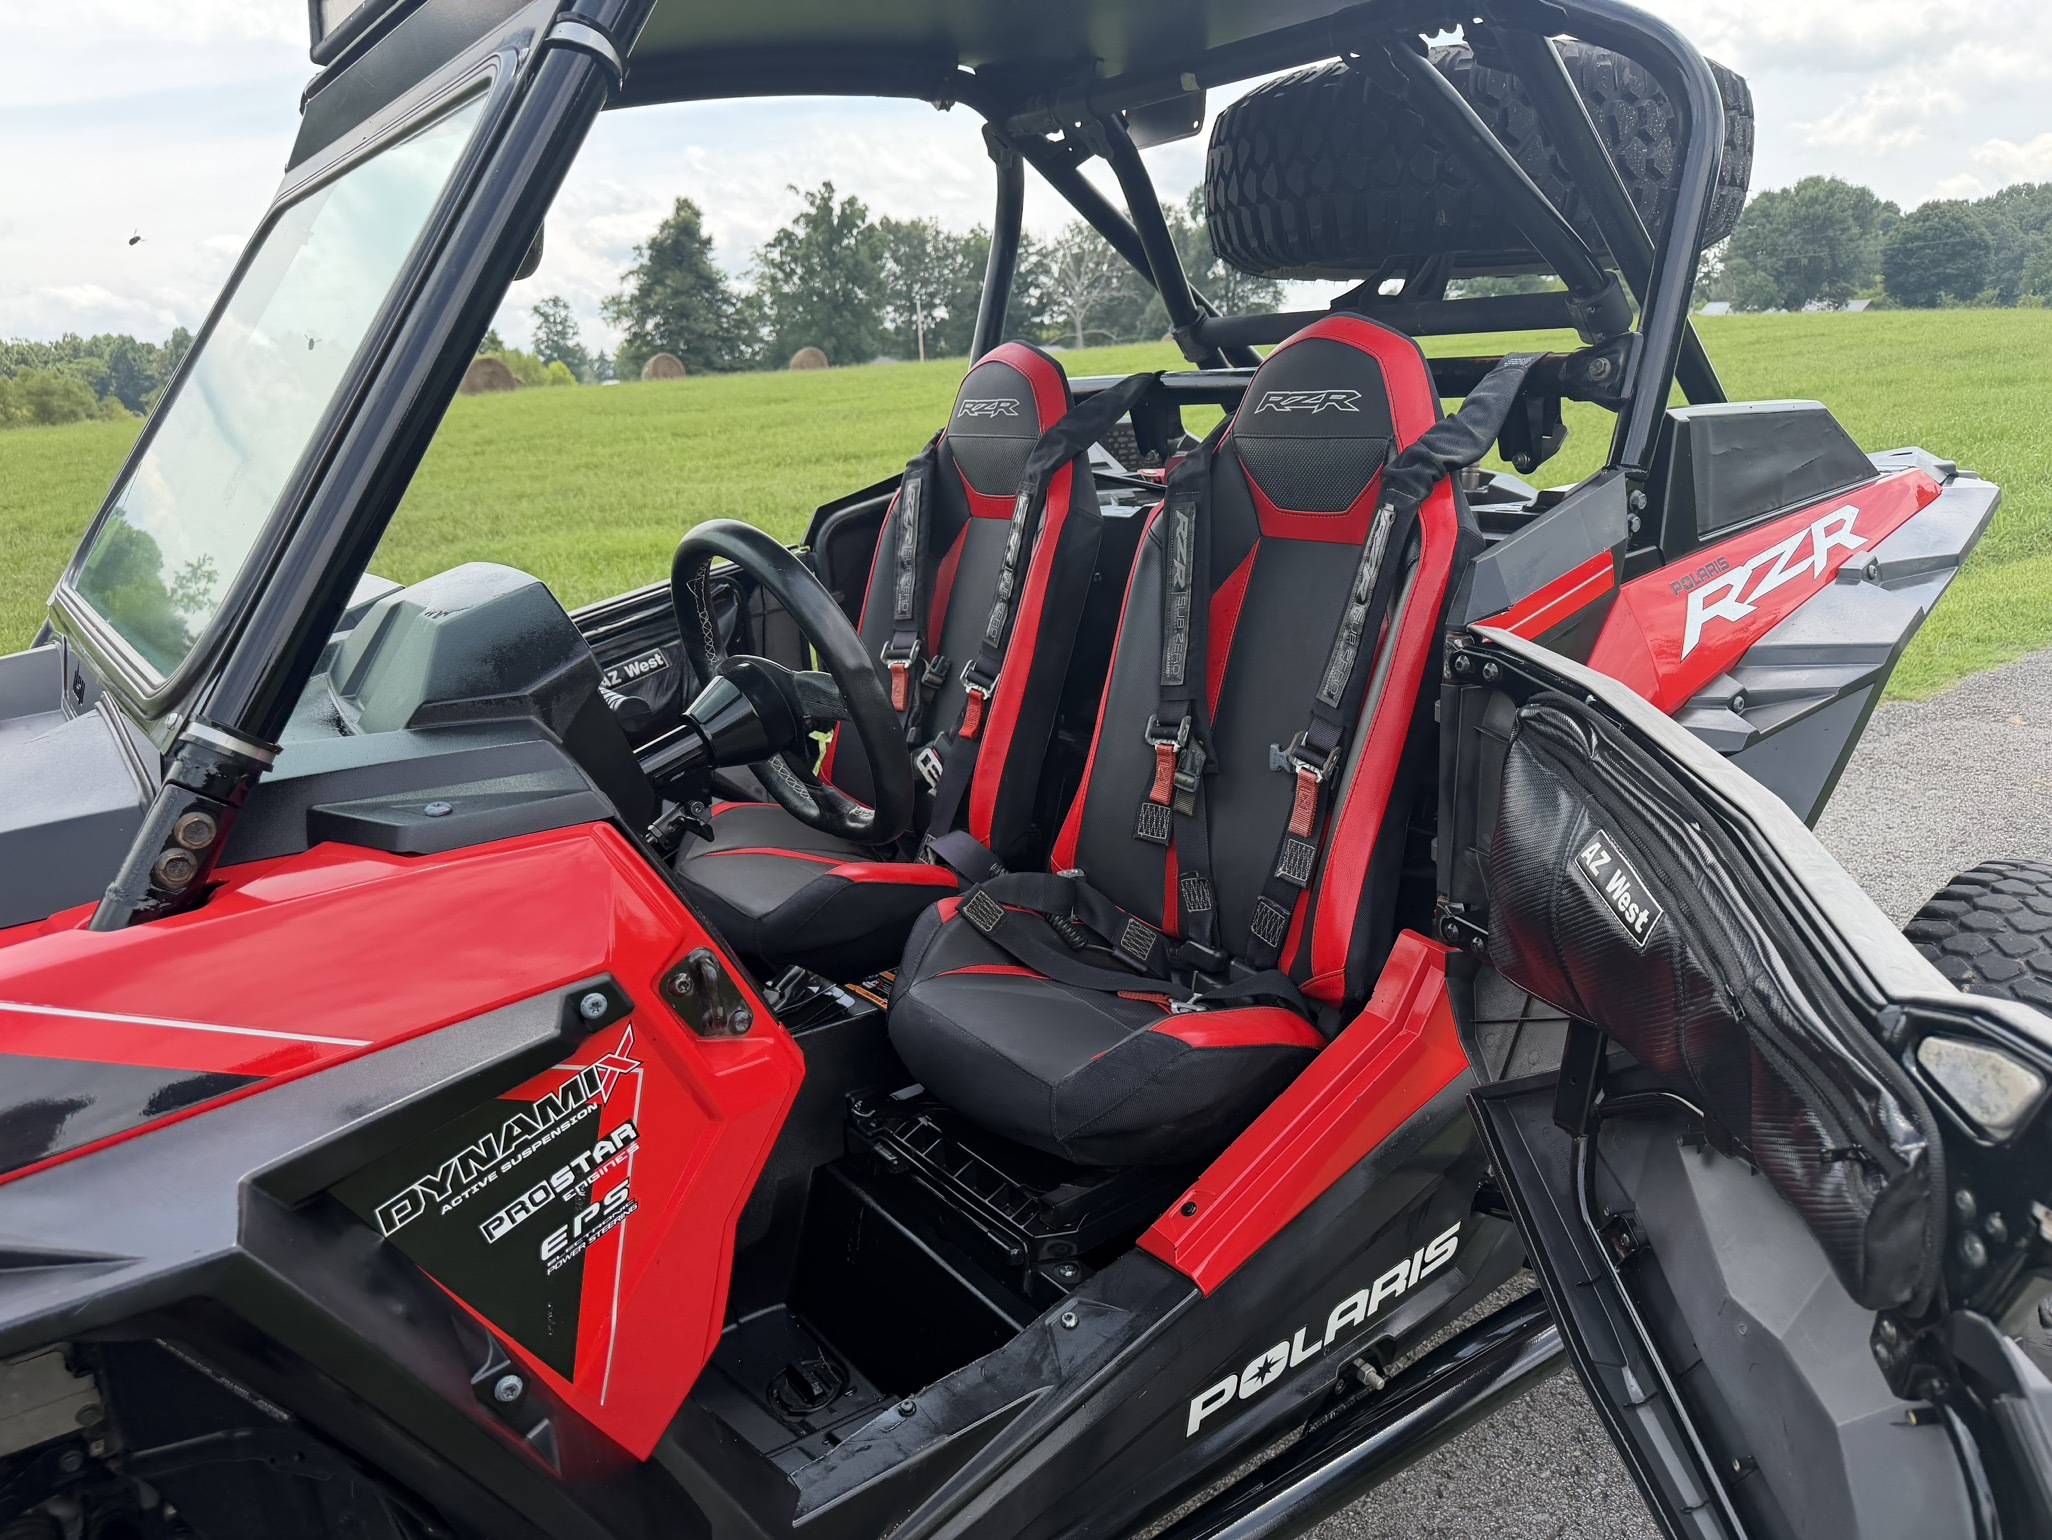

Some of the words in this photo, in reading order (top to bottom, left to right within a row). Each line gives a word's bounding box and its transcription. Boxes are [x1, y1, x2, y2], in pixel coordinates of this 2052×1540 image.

[958, 398, 1020, 418] RZR
[1254, 389, 1362, 414] RZR
[1173, 509, 1189, 589] RZR
[1357, 509, 1388, 602] RZR
[1669, 556, 1730, 597] POLARIS
[1680, 504, 1870, 664] RZR
[1176, 595, 1187, 630] SUB
[1349, 609, 1365, 647] SUB
[600, 670, 622, 687] AZ
[624, 654, 664, 678] West
[1170, 634, 1185, 676] ZERO
[1330, 650, 1357, 695] ZERO
[1580, 841, 1612, 877] AZ
[1605, 868, 1650, 934] West
[374, 1019, 644, 1238] DYNAMIX
[441, 1170, 499, 1215] ACTIVE
[500, 1101, 598, 1173] SUSPENSION
[479, 1122, 638, 1244] PROSTAR
[562, 1142, 640, 1202] ENGINES
[541, 1179, 630, 1261] EPS
[547, 1198, 636, 1267] ELECTRONIC
[547, 1241, 586, 1275] POWER
[588, 1203, 638, 1243] STEERING
[1186, 1220, 1462, 1438] POLARIS
